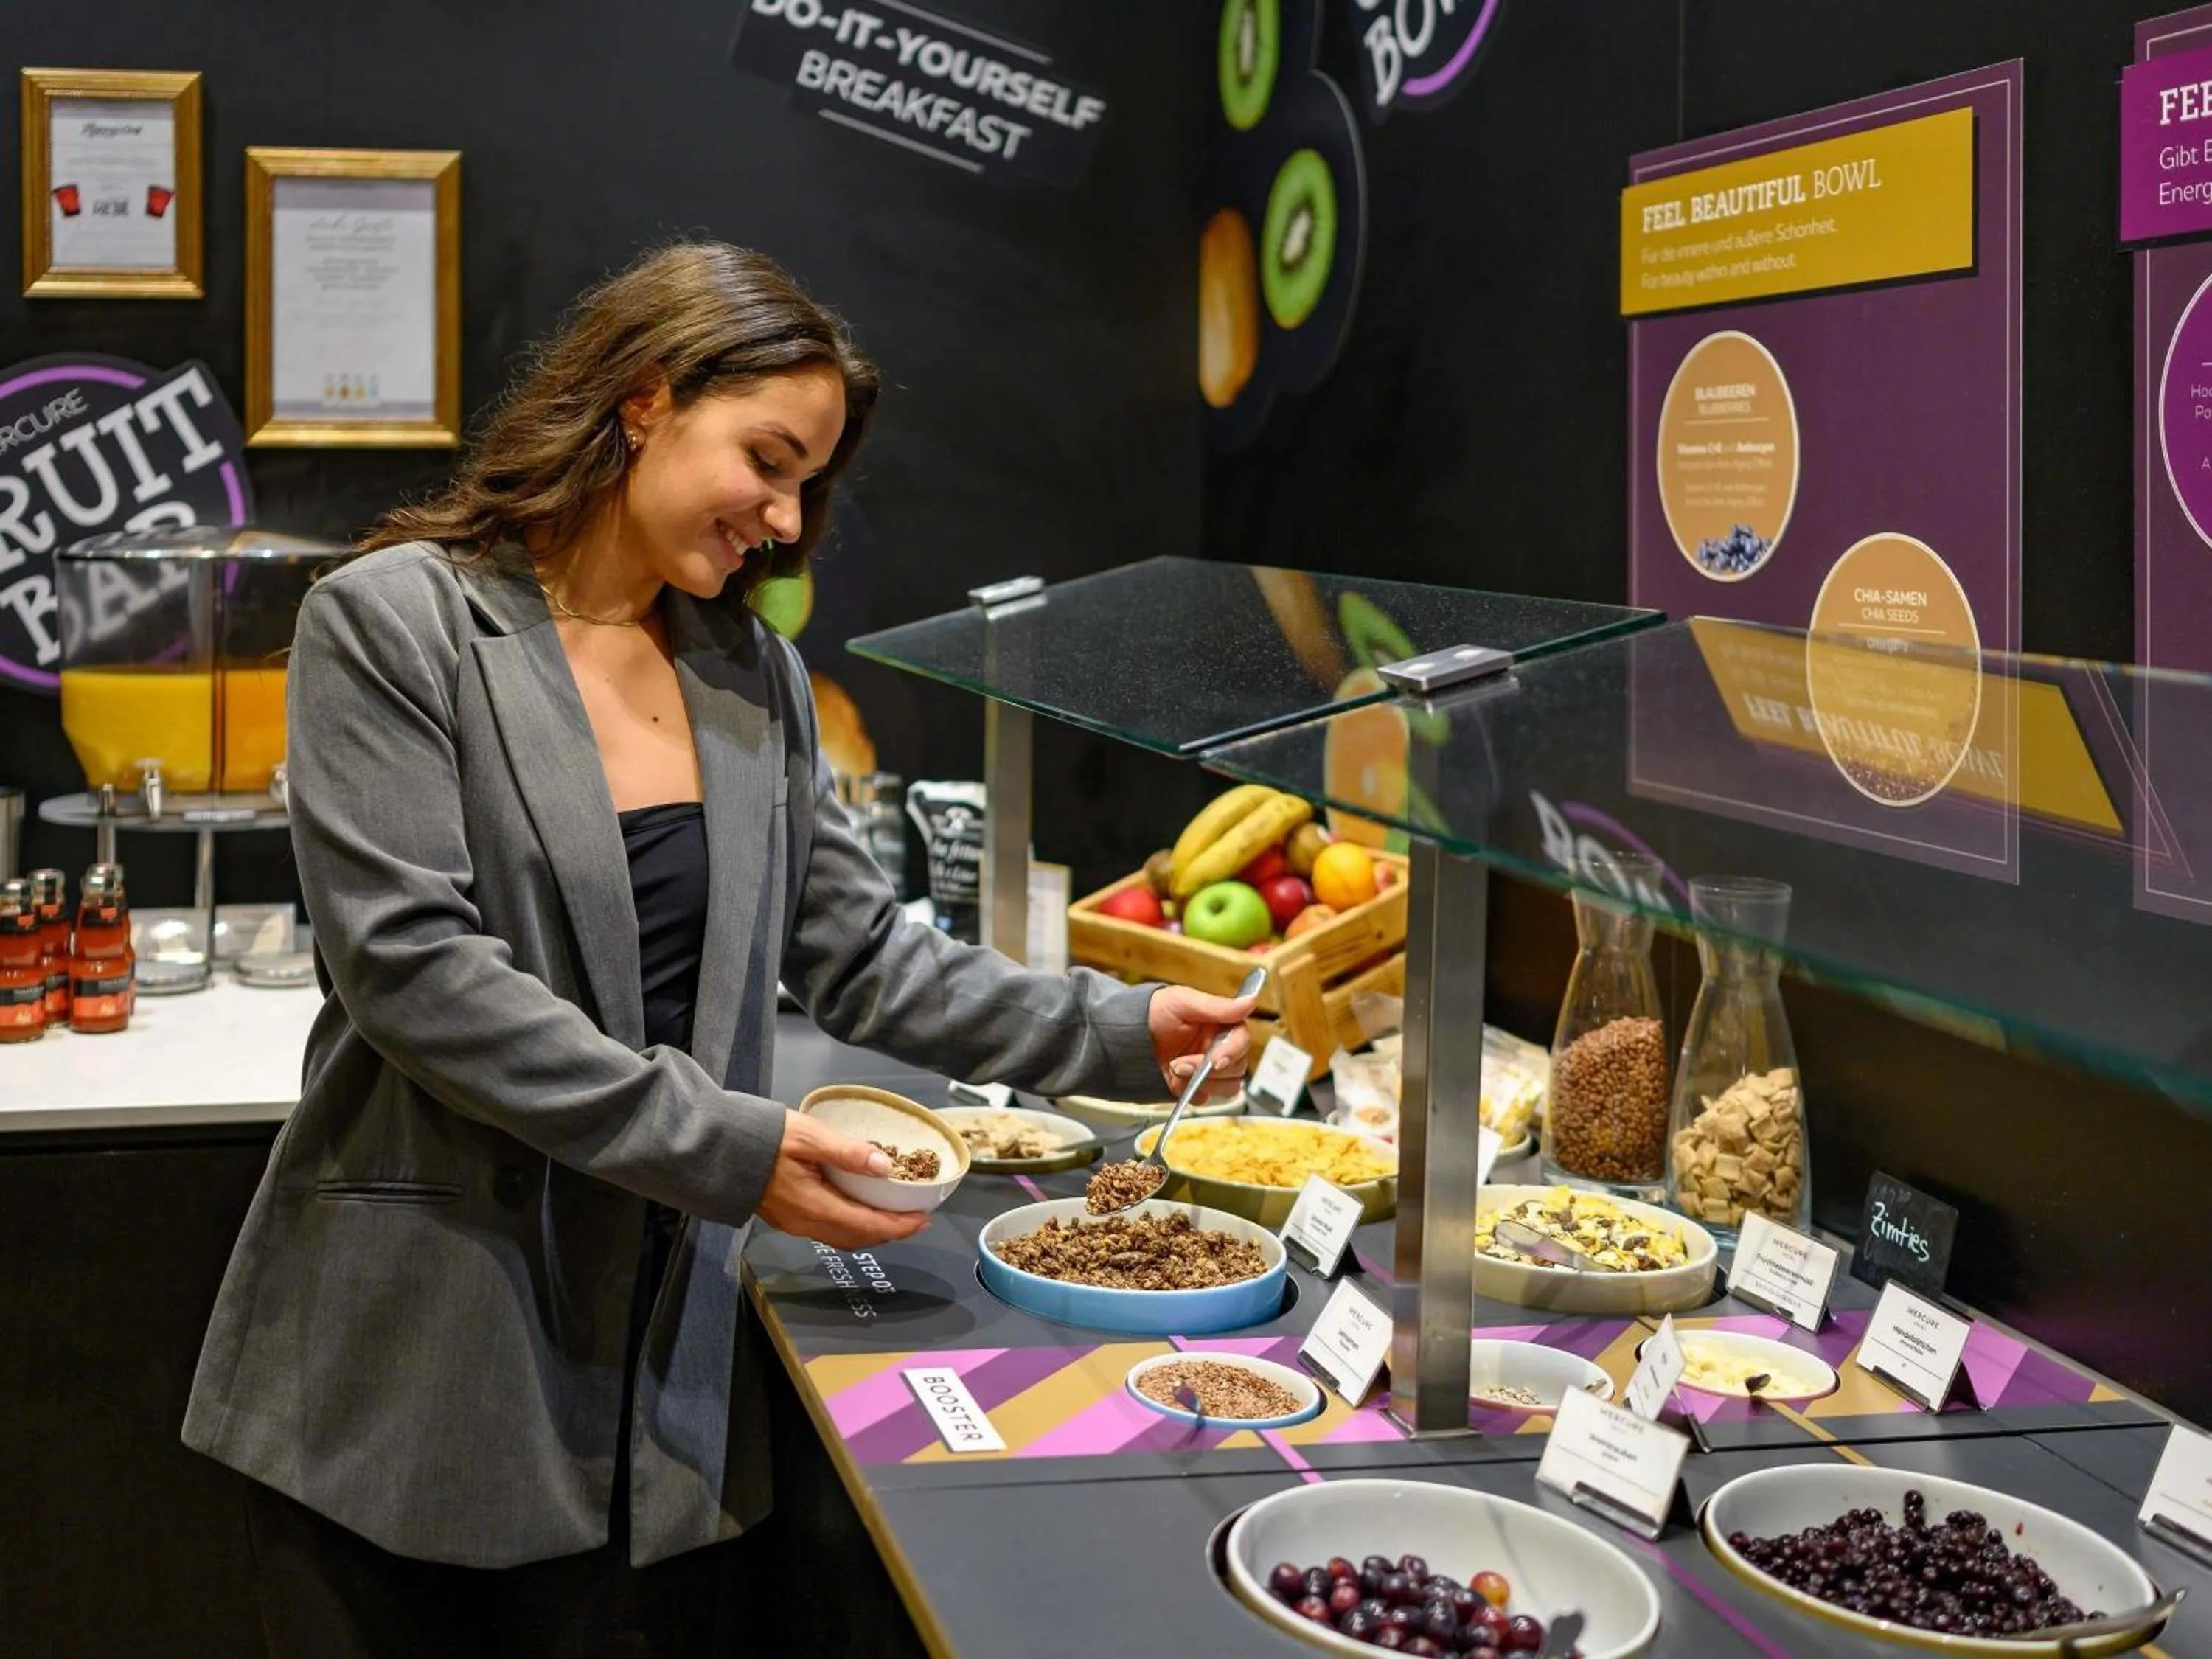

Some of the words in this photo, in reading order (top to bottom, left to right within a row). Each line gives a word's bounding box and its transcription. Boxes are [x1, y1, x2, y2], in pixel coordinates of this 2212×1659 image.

[796, 49, 1032, 160] BREAKFAST
[2160, 80, 2212, 126] FEE
[2160, 144, 2199, 170] Gibt
[2203, 139, 2212, 162] E
[1642, 201, 1686, 234] FEEL
[1690, 175, 1806, 224] BEAUTIFUL
[1812, 158, 1882, 200] BOWL
[2160, 181, 2212, 206] Energ
[2191, 383, 2212, 398] Ho
[0, 387, 90, 456] RCURE
[2195, 405, 2212, 420] Po
[0, 366, 224, 574] RUIT
[1854, 588, 1927, 607] CHIA-SAMEN
[1860, 606, 1885, 621] CHIA
[1885, 608, 1919, 625] SEEDS
[852, 1253, 886, 1279] STEP
[922, 1376, 984, 1441] BOOSTER
